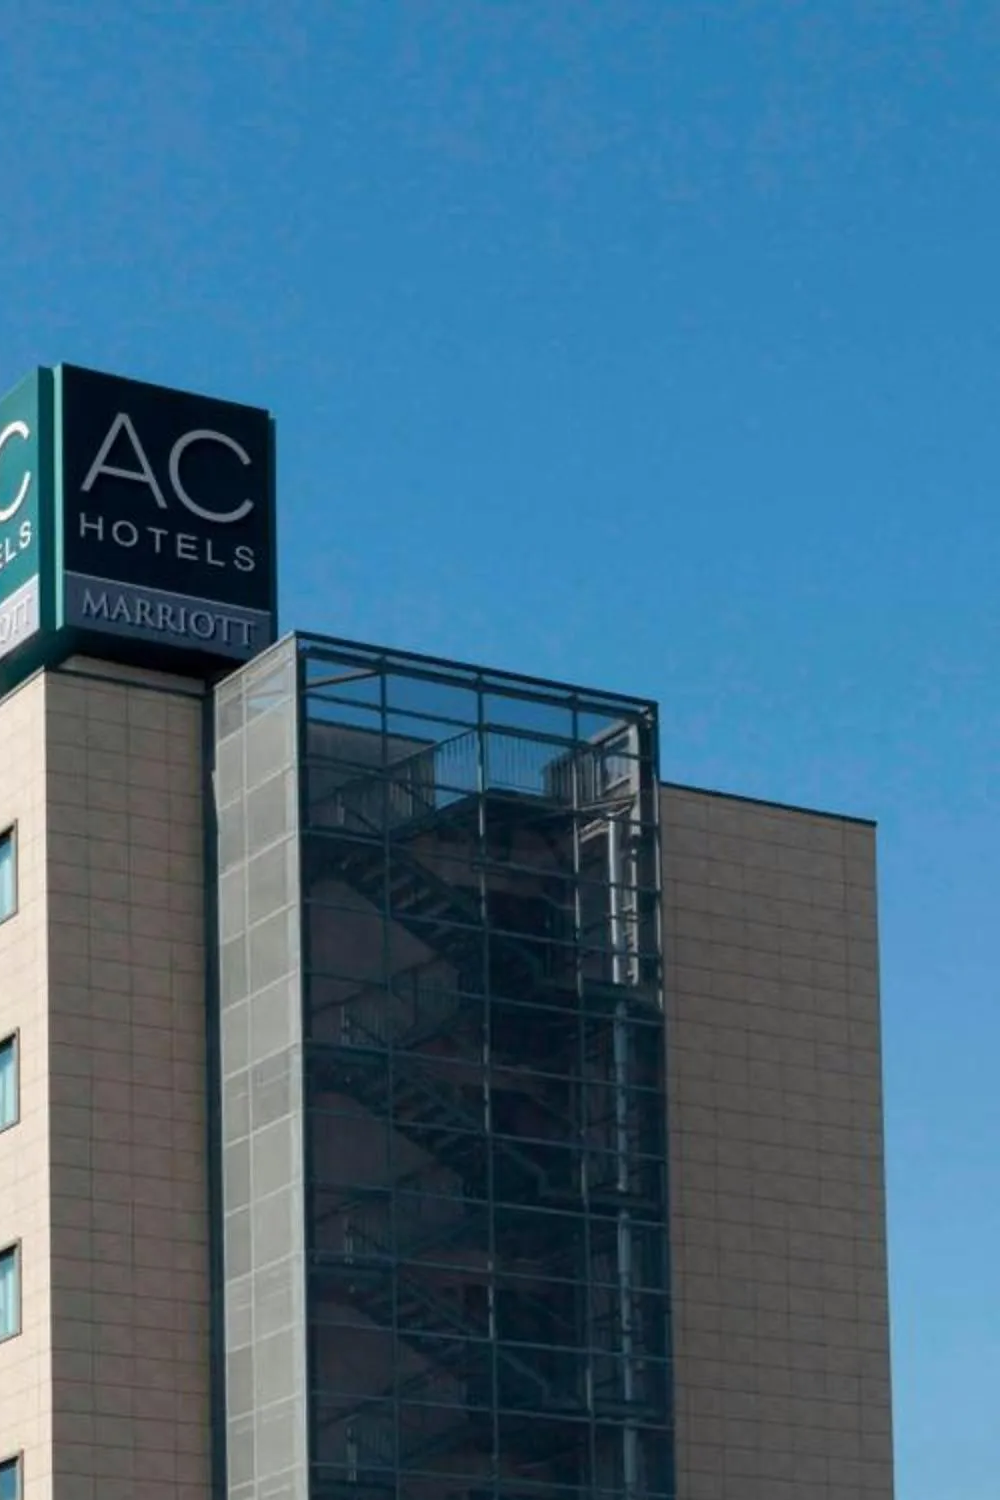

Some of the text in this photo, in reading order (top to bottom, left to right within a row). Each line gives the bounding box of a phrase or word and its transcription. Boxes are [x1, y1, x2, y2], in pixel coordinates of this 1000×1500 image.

[80, 412, 254, 523] AC
[79, 512, 256, 572] HOTELS
[82, 588, 257, 646] MARRIOTT
